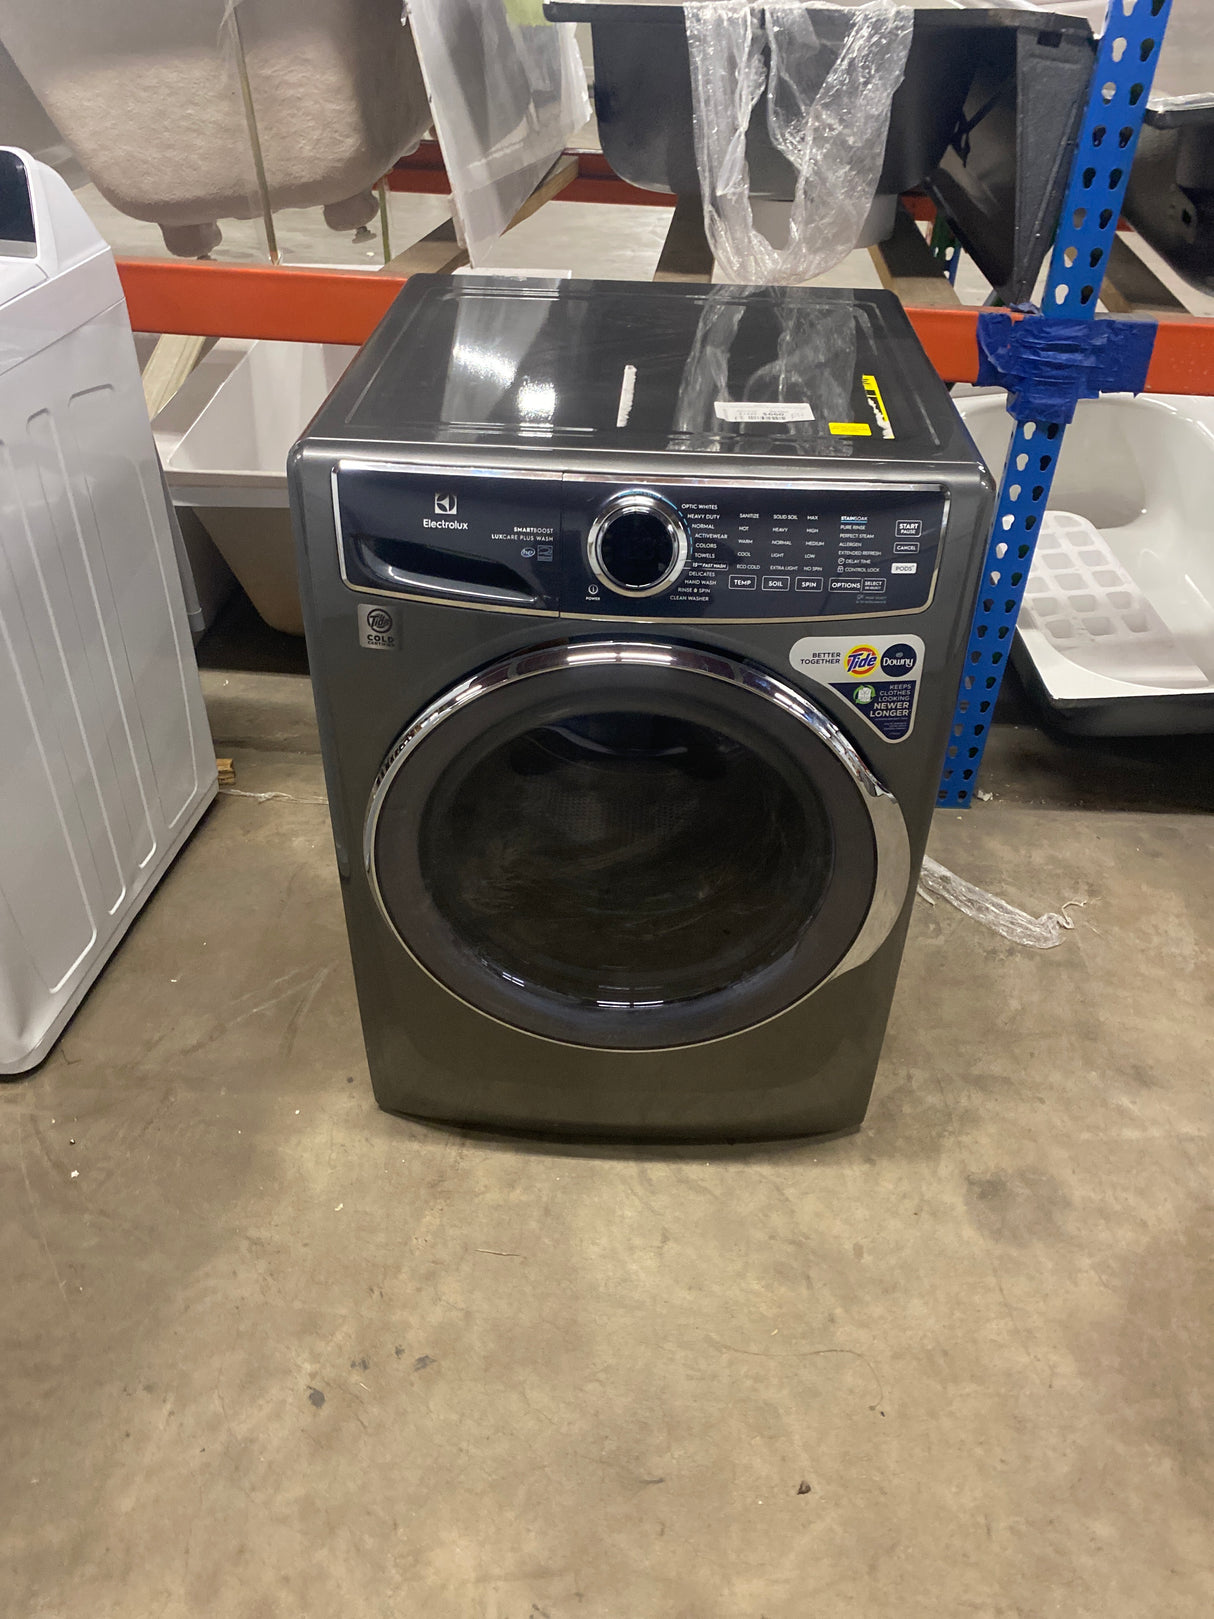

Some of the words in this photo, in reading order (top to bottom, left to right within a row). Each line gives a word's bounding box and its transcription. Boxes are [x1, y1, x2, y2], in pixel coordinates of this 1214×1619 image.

[422, 518, 469, 530] Electrolux
[513, 526, 554, 534] SMARTBOOST
[491, 533, 518, 541] LUXCARE
[367, 634, 394, 643] COLD
[847, 652, 878, 672] Tide
[882, 657, 914, 667] Downy
[873, 701, 910, 710] NEWER
[869, 709, 909, 718] LONGER
